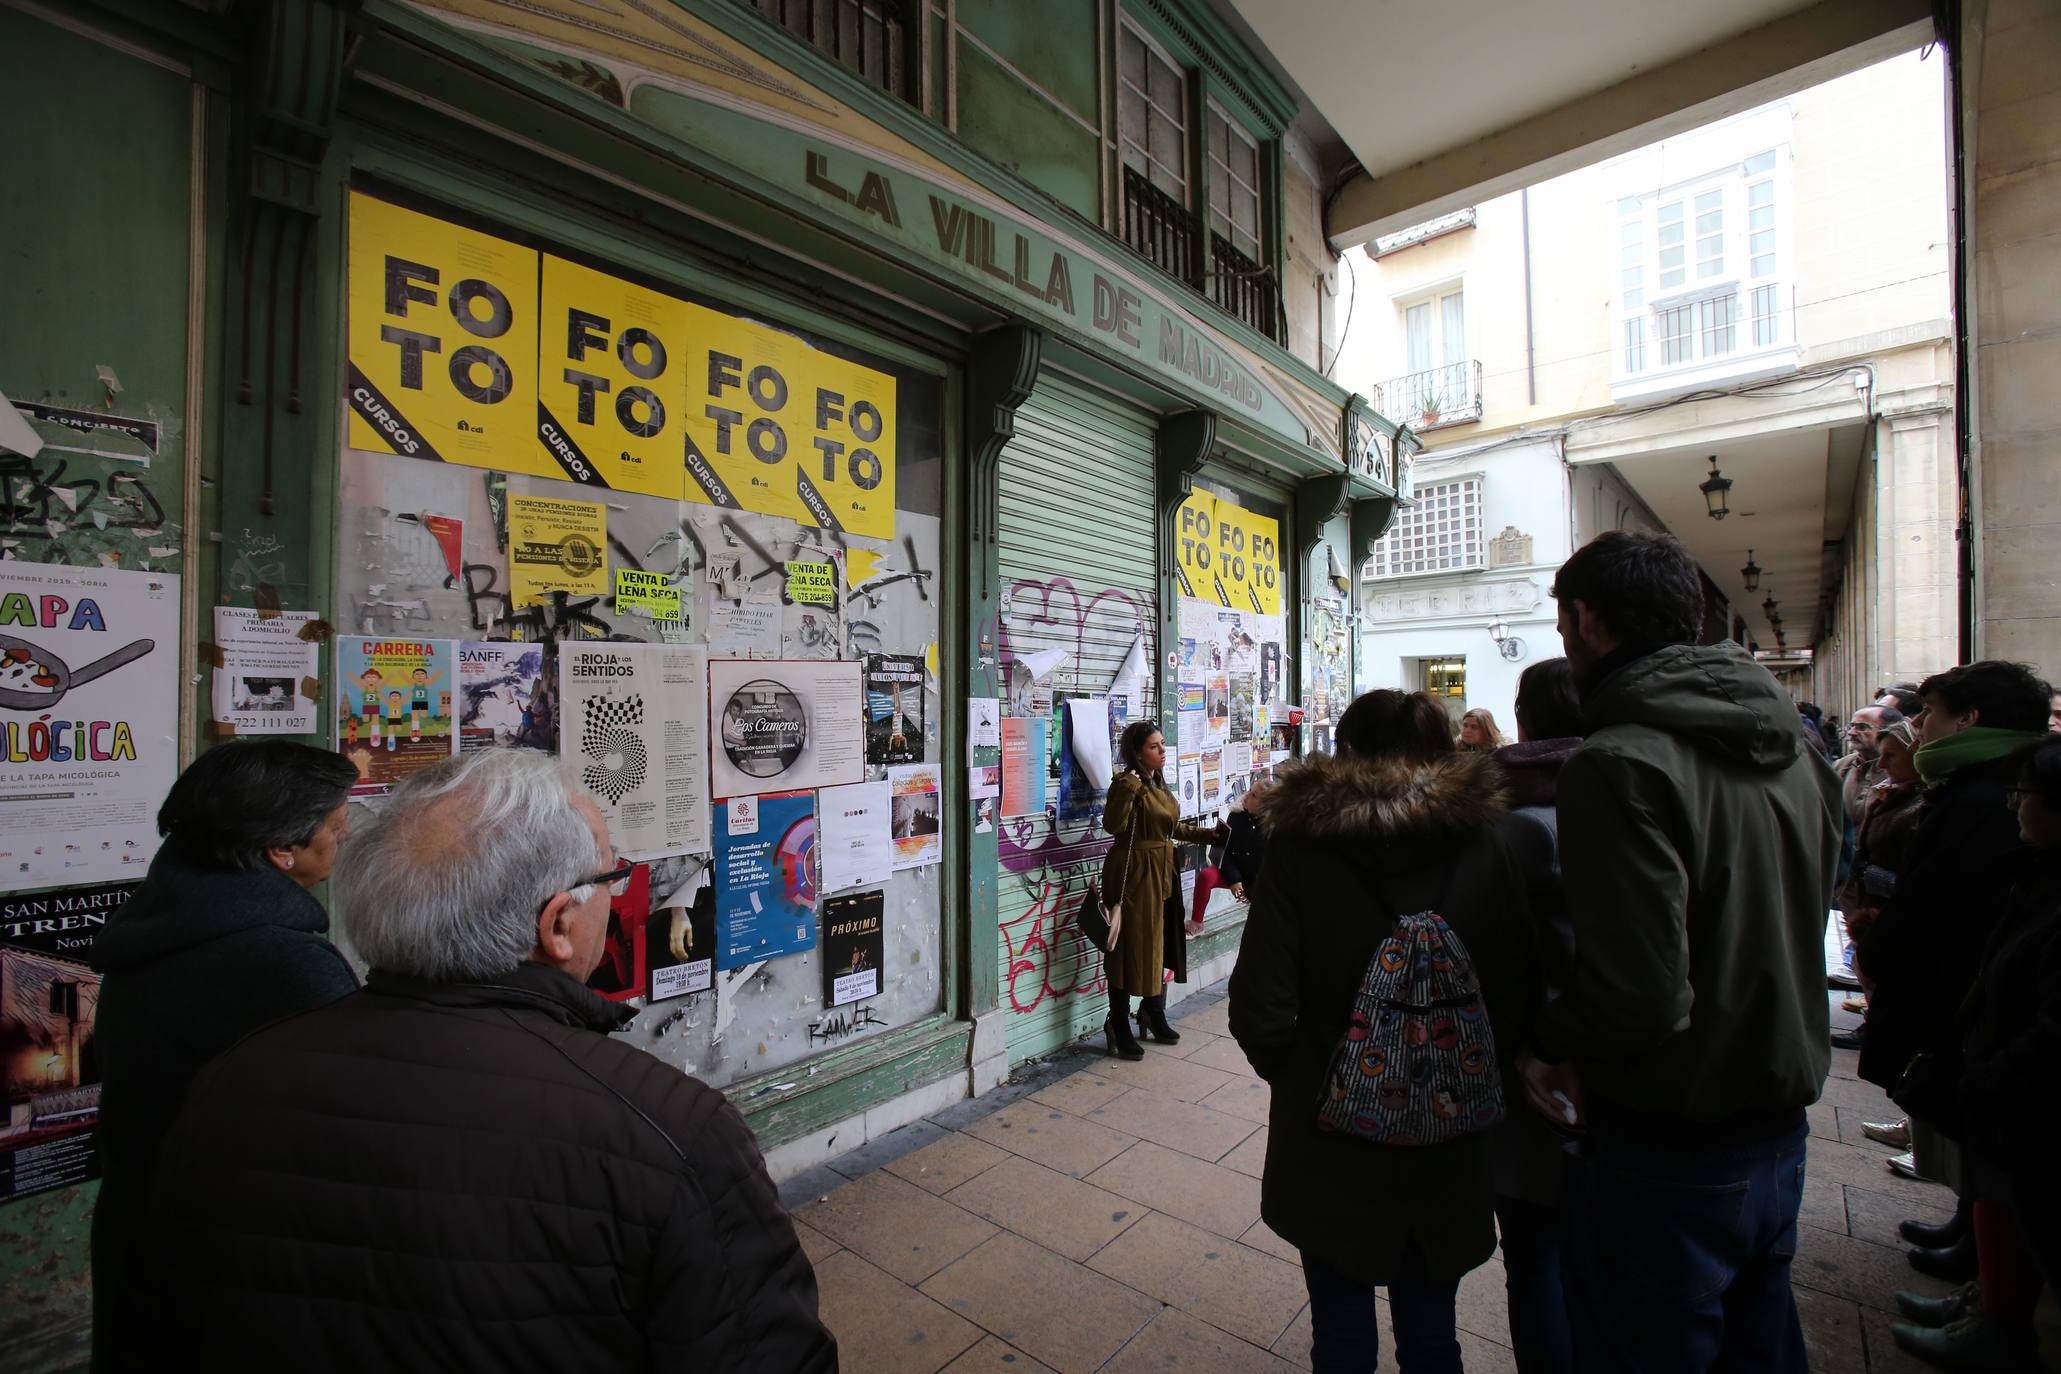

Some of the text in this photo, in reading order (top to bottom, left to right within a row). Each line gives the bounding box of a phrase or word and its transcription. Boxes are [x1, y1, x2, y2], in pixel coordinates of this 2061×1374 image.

[806, 150, 1263, 411] LA VILLA DE MADRID
[385, 254, 513, 338] FO
[567, 307, 667, 380] FO
[381, 324, 513, 405] TO
[709, 349, 788, 412] FO
[563, 367, 666, 438] TO
[353, 387, 419, 454] CURSOS
[816, 387, 883, 443] FO
[705, 404, 788, 465] TO
[541, 423, 591, 482] CURSOS
[814, 436, 882, 490] TO
[687, 453, 728, 505] CURSOS
[514, 500, 597, 513] CONCENTRACIONES
[799, 481, 833, 527] CURSOS
[1182, 506, 1210, 538] FO
[1220, 522, 1245, 552] FO
[544, 547, 563, 555] LAS
[1182, 537, 1211, 570] TO
[1252, 534, 1275, 561] FO
[788, 563, 827, 574] VENTA DE
[1220, 552, 1245, 582] TO
[1252, 562, 1275, 589] TO
[622, 572, 668, 586] VENTA D
[790, 573, 831, 586] EÑA SECA
[618, 584, 647, 597] LEÑA
[249, 626, 291, 634] DOMICILIO
[362, 641, 434, 656] CARRERA
[459, 650, 502, 662] BANFF
[581, 654, 618, 664] RIOJA
[234, 718, 307, 727] 722 111 027
[755, 717, 800, 732] Cameros
[11, 774, 24, 782] LA
[28, 773, 55, 782] TAPA
[59, 770, 121, 780] MICOLÓGICA
[728, 843, 761, 853] Jornadas
[728, 850, 764, 860] desarrollo
[728, 859, 749, 868] social
[729, 866, 762, 876] exclusión
[750, 872, 769, 880] Rioja
[4, 900, 48, 918] SAN
[0, 912, 109, 937] TREN
[831, 917, 877, 936] PRÓXIMO
[656, 968, 681, 977] TEATRO
